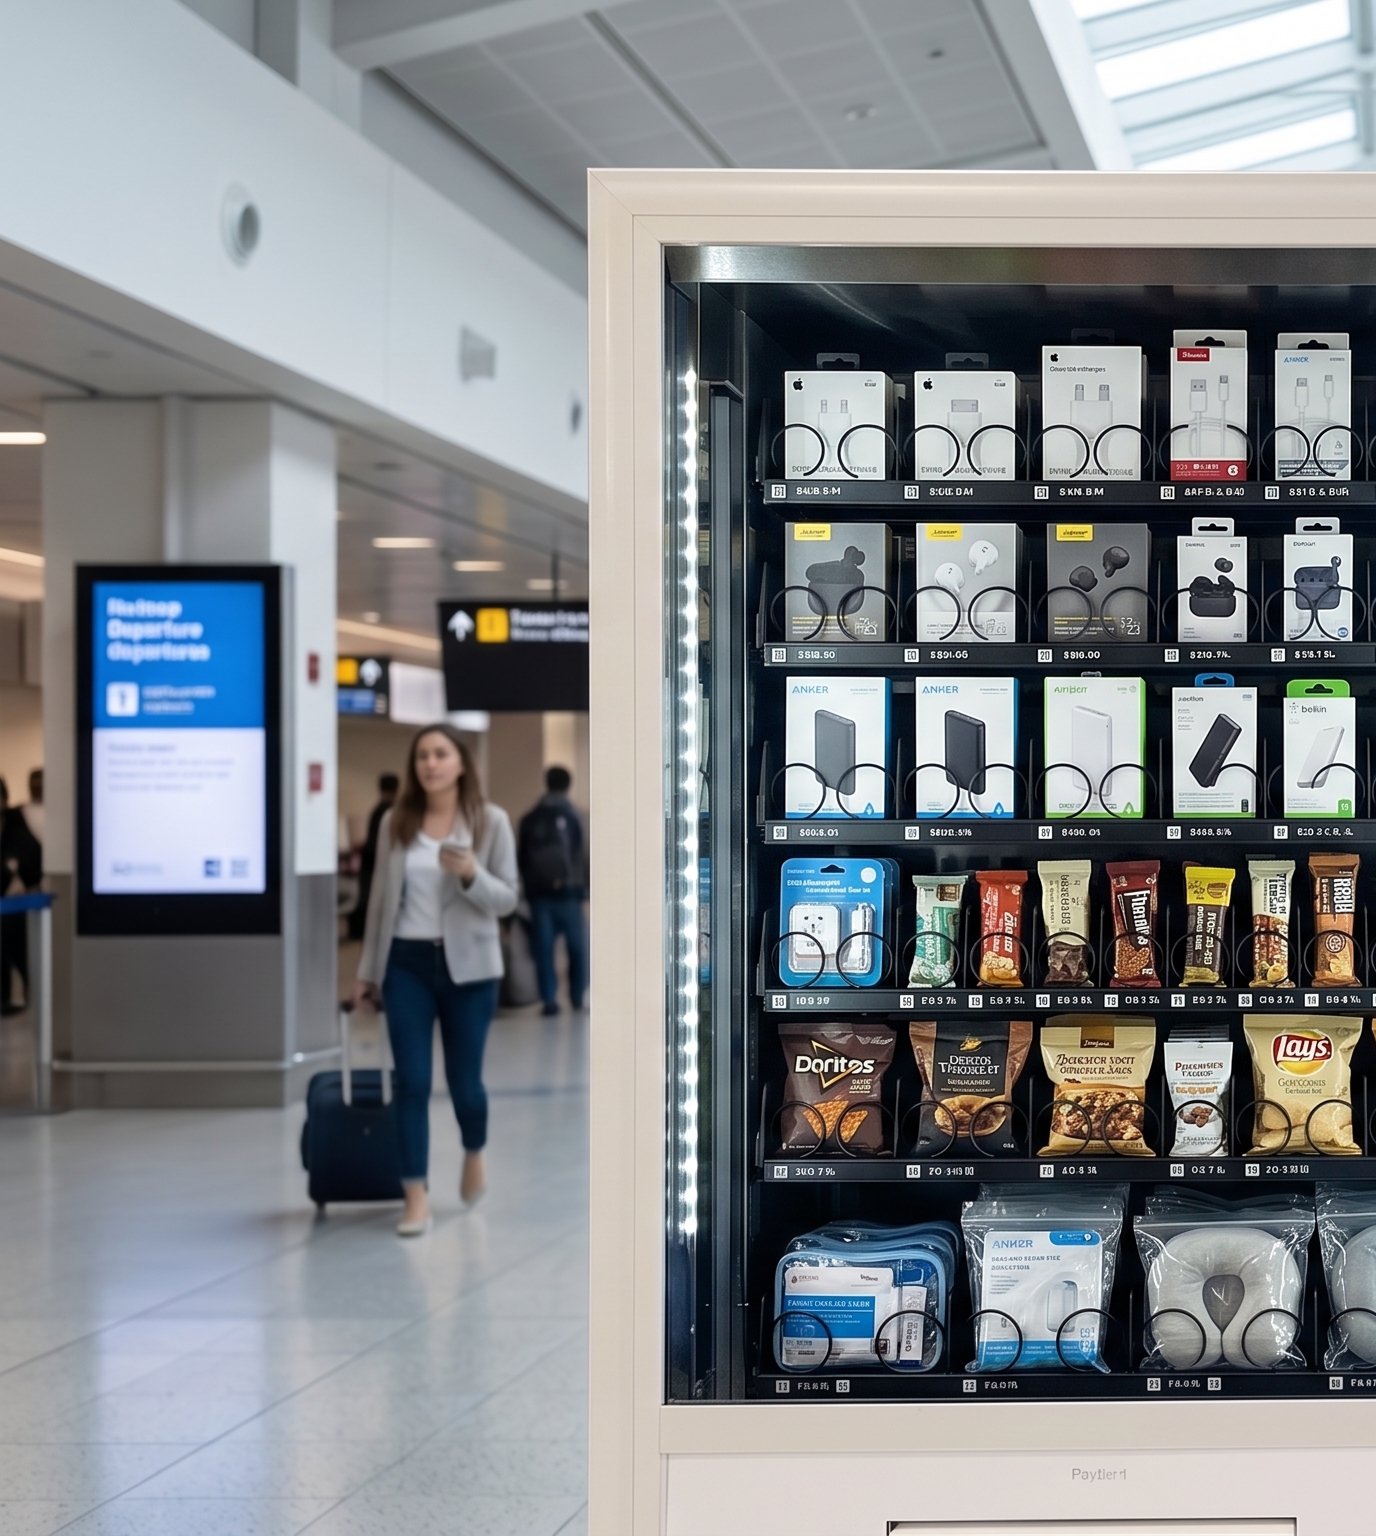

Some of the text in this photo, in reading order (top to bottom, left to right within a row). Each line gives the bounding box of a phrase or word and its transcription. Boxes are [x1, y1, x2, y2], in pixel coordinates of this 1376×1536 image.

[792, 685, 829, 695] ANKER
[922, 685, 959, 695] ANKER
[795, 1054, 875, 1074] Doritos
